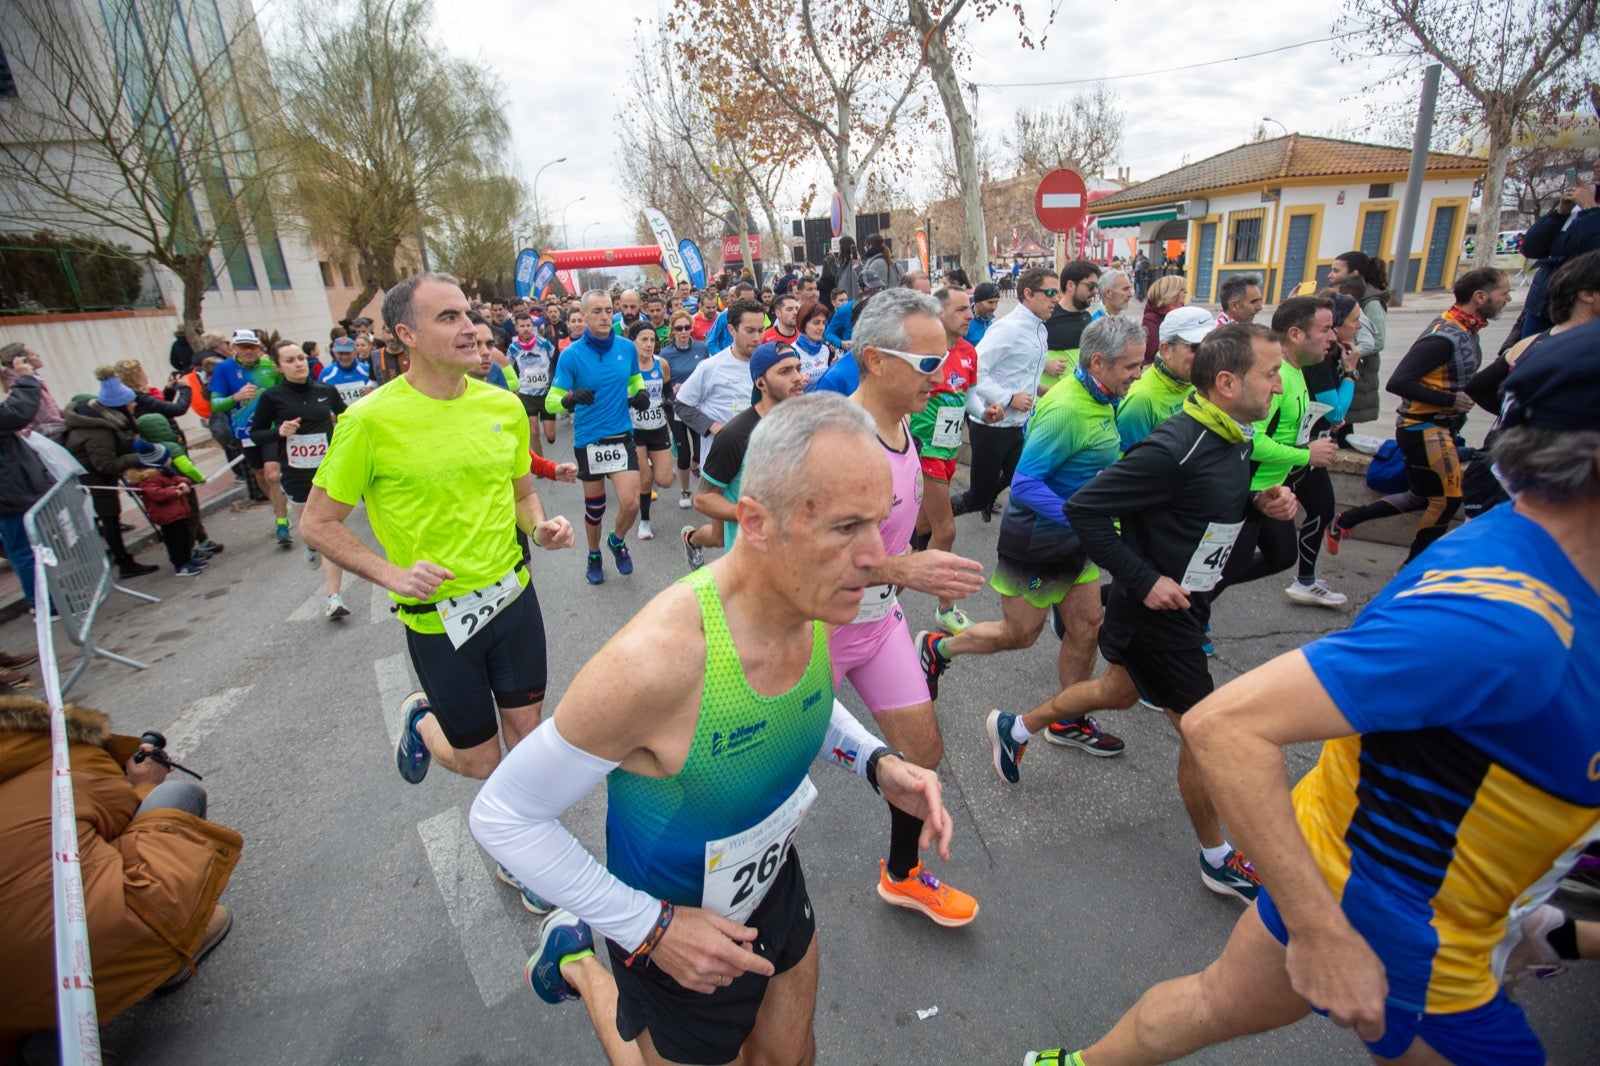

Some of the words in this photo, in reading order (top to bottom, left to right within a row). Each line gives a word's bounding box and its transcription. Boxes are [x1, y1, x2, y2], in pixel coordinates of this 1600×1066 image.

[527, 373, 547, 384] 3045
[636, 409, 662, 422] 3035
[290, 443, 327, 458] 2022
[595, 449, 621, 463] 866
